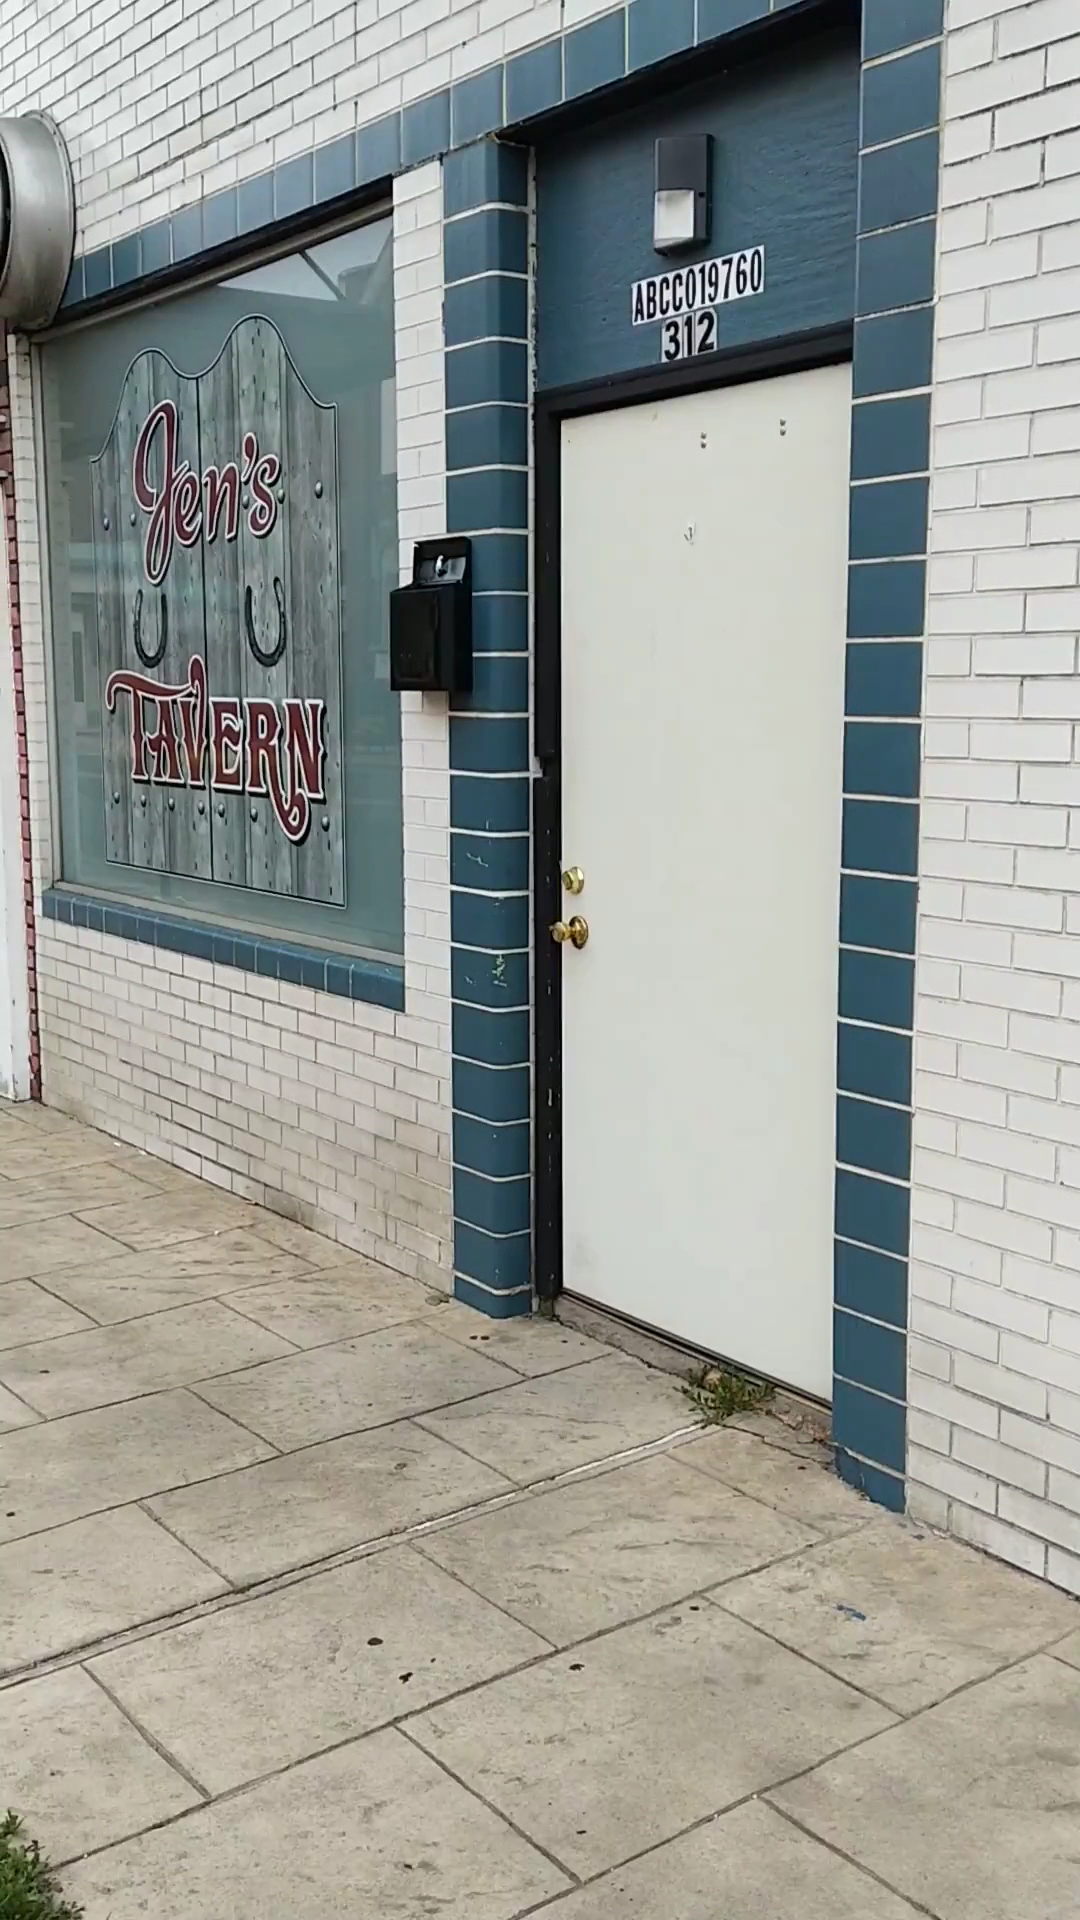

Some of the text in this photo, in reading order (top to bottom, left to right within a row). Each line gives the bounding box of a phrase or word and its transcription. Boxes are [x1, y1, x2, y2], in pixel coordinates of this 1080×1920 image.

[664, 311, 715, 361] 312
[133, 399, 280, 584] Jen's
[105, 654, 325, 842] TAVERN
